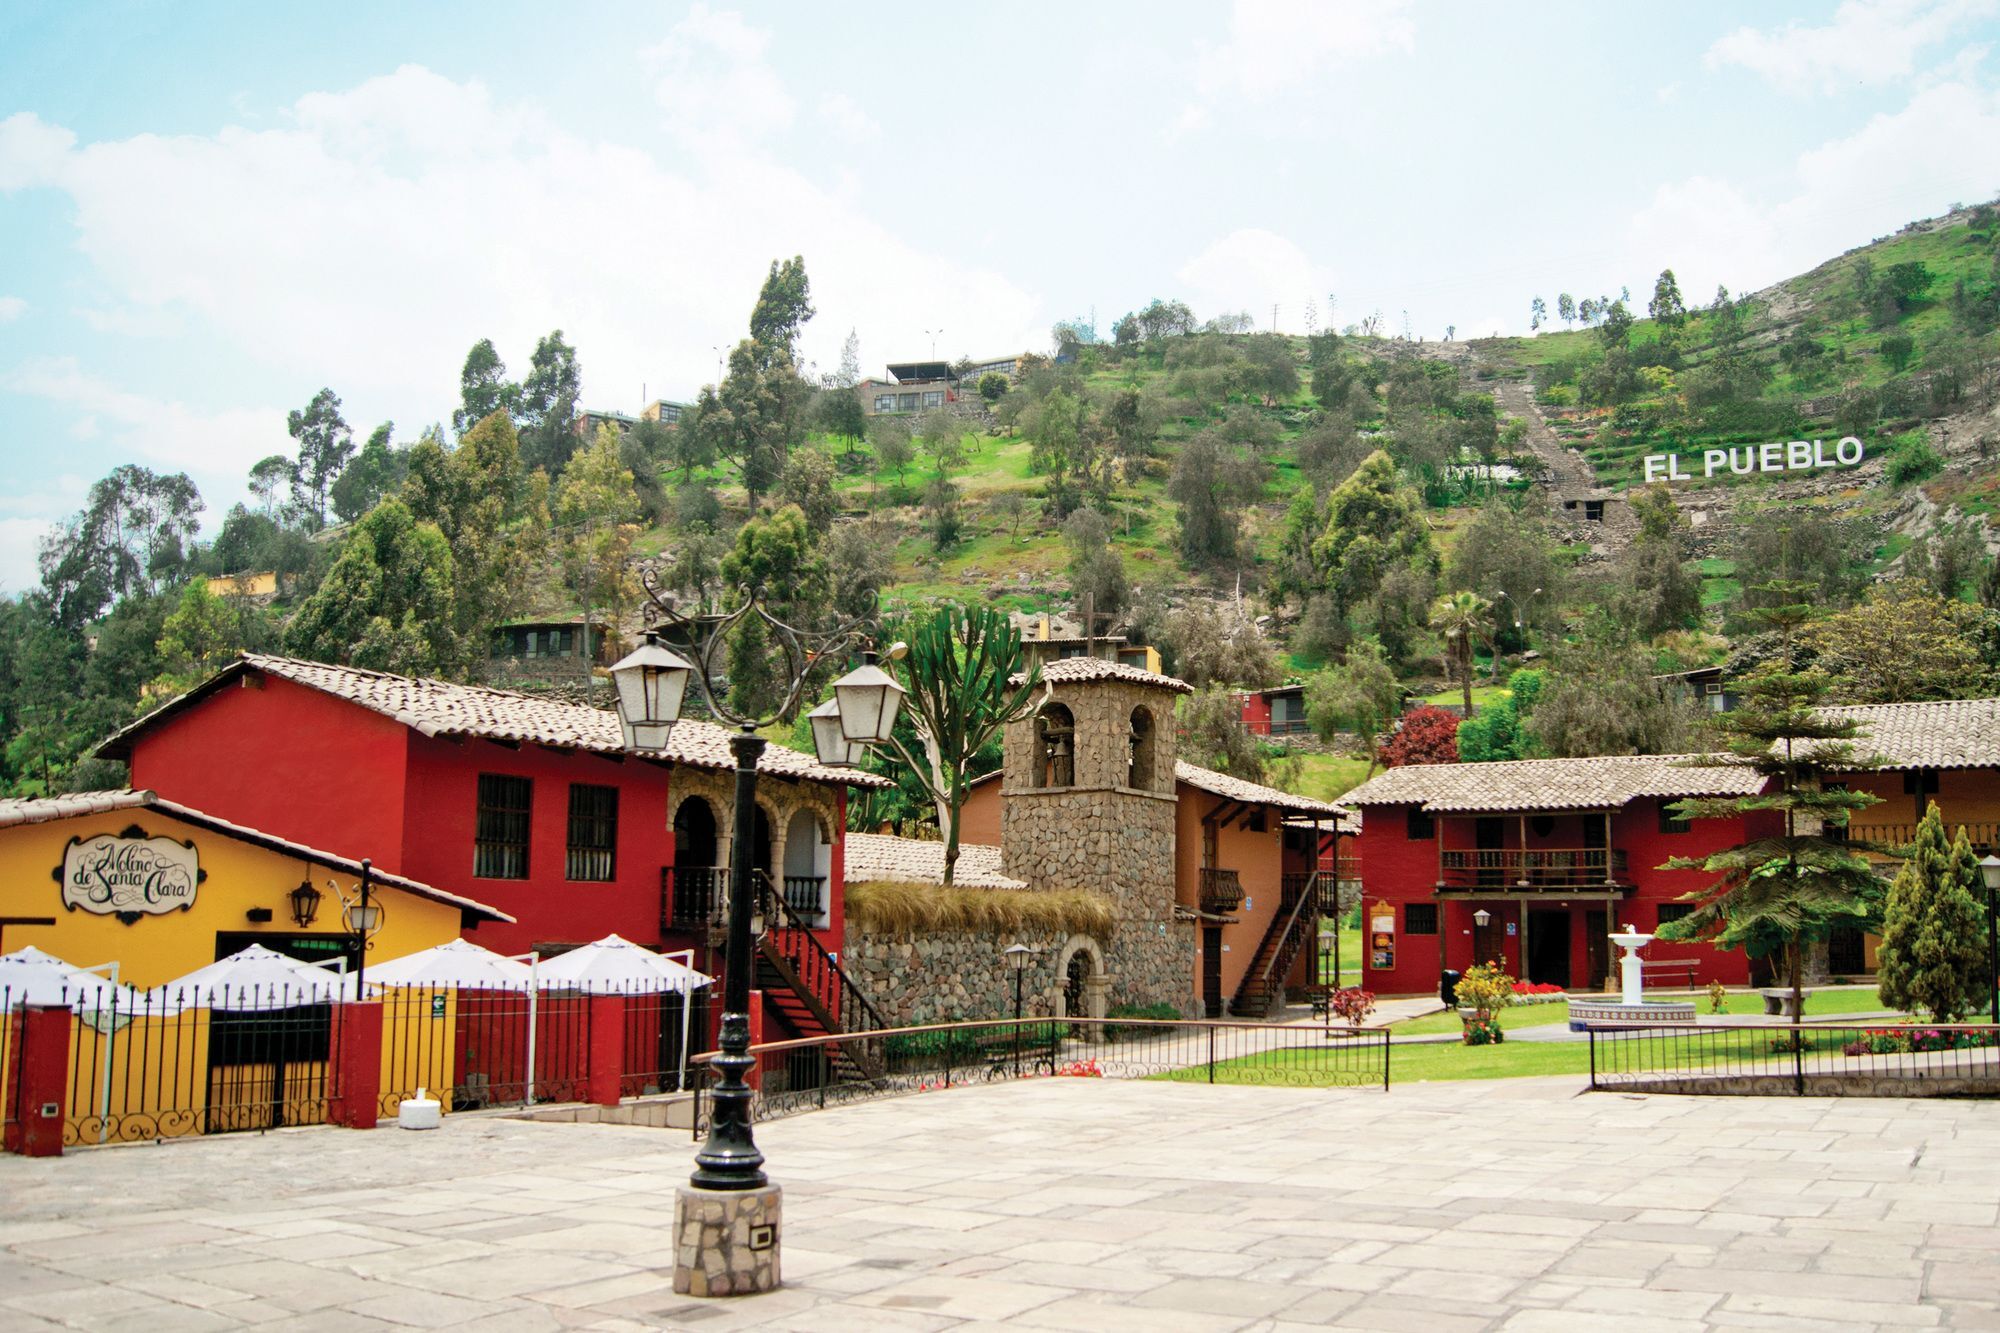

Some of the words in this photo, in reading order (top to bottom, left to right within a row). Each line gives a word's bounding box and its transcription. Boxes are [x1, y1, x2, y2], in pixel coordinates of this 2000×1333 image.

[1644, 453, 1691, 482] EL
[1704, 436, 1863, 478] PUEBLO
[96, 842, 153, 874] Molino
[73, 864, 92, 886] de
[89, 859, 144, 903] Santa
[144, 869, 190, 904] Clara
